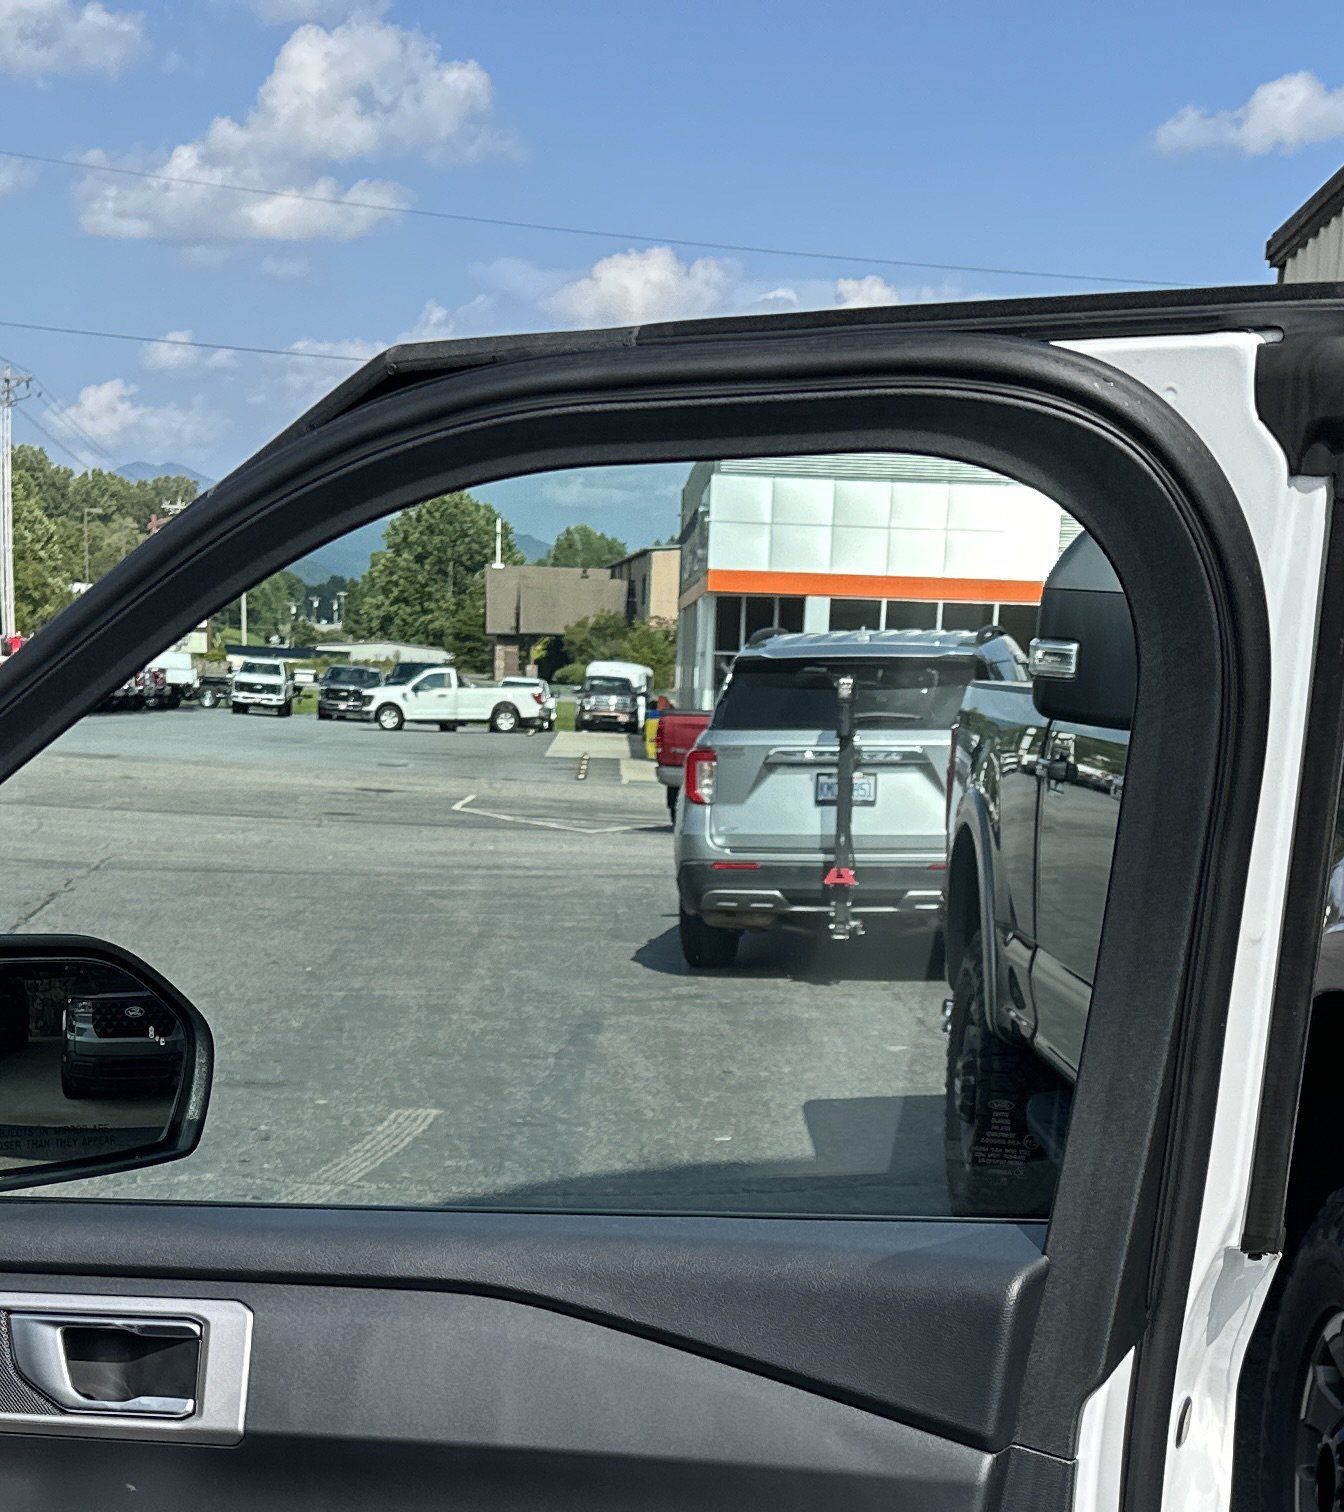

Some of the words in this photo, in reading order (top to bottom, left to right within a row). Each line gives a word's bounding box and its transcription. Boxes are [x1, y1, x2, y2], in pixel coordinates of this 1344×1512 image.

[27, 1138, 51, 1149] THAN
[56, 1137, 78, 1149] THEY
[81, 1135, 116, 1147] APPEAR
